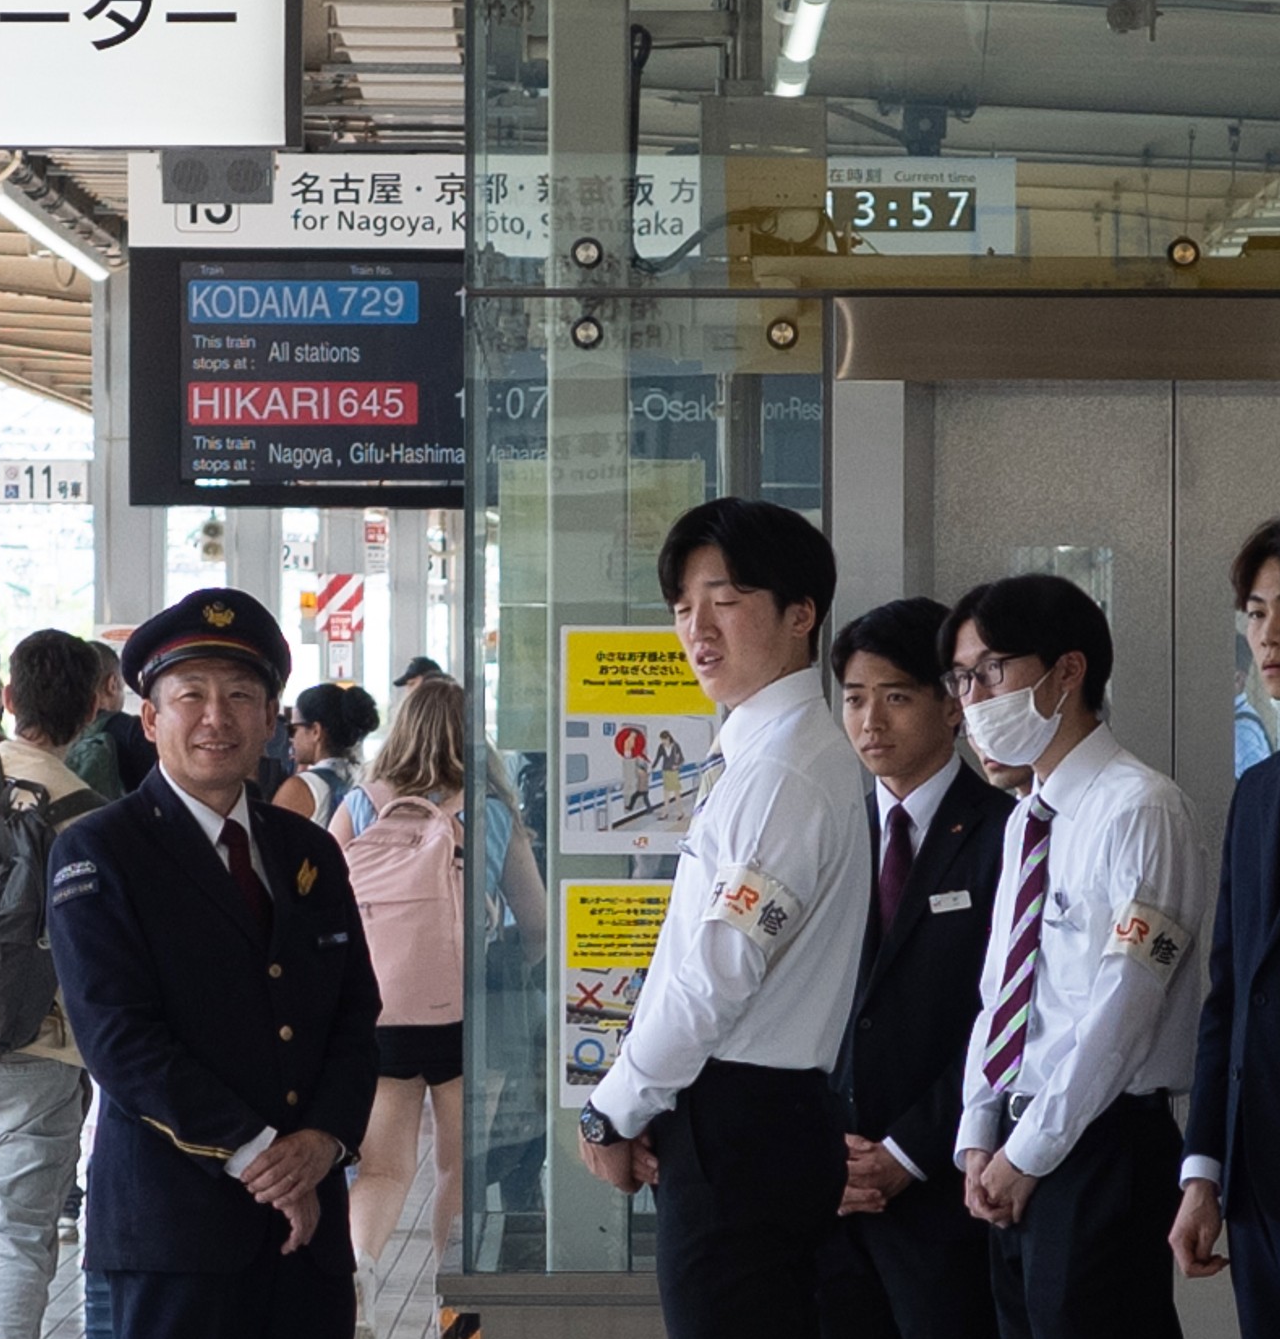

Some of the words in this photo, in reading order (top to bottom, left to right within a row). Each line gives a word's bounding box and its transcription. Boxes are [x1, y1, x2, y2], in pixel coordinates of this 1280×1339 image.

[829, 167, 882, 183] 在時刻
[894, 170, 945, 183] Current
[948, 169, 976, 183] time
[292, 208, 329, 231] for
[337, 210, 442, 238] Nagoya,
[190, 285, 332, 319] KODAMA
[337, 286, 406, 318] 729
[191, 333, 223, 350] This
[226, 333, 257, 350] train
[267, 341, 291, 364] All
[293, 341, 361, 364] stations
[192, 357, 231, 373] stops
[191, 386, 332, 420] HIKARI
[337, 387, 406, 419] 645
[191, 434, 223, 451] This
[226, 434, 257, 451] train
[192, 458, 231, 473] stops
[23, 464, 83, 500] 11号車
[725, 884, 760, 911] JR
[756, 898, 789, 937] 修
[1116, 917, 1151, 944] JR
[1149, 930, 1179, 966] 修
